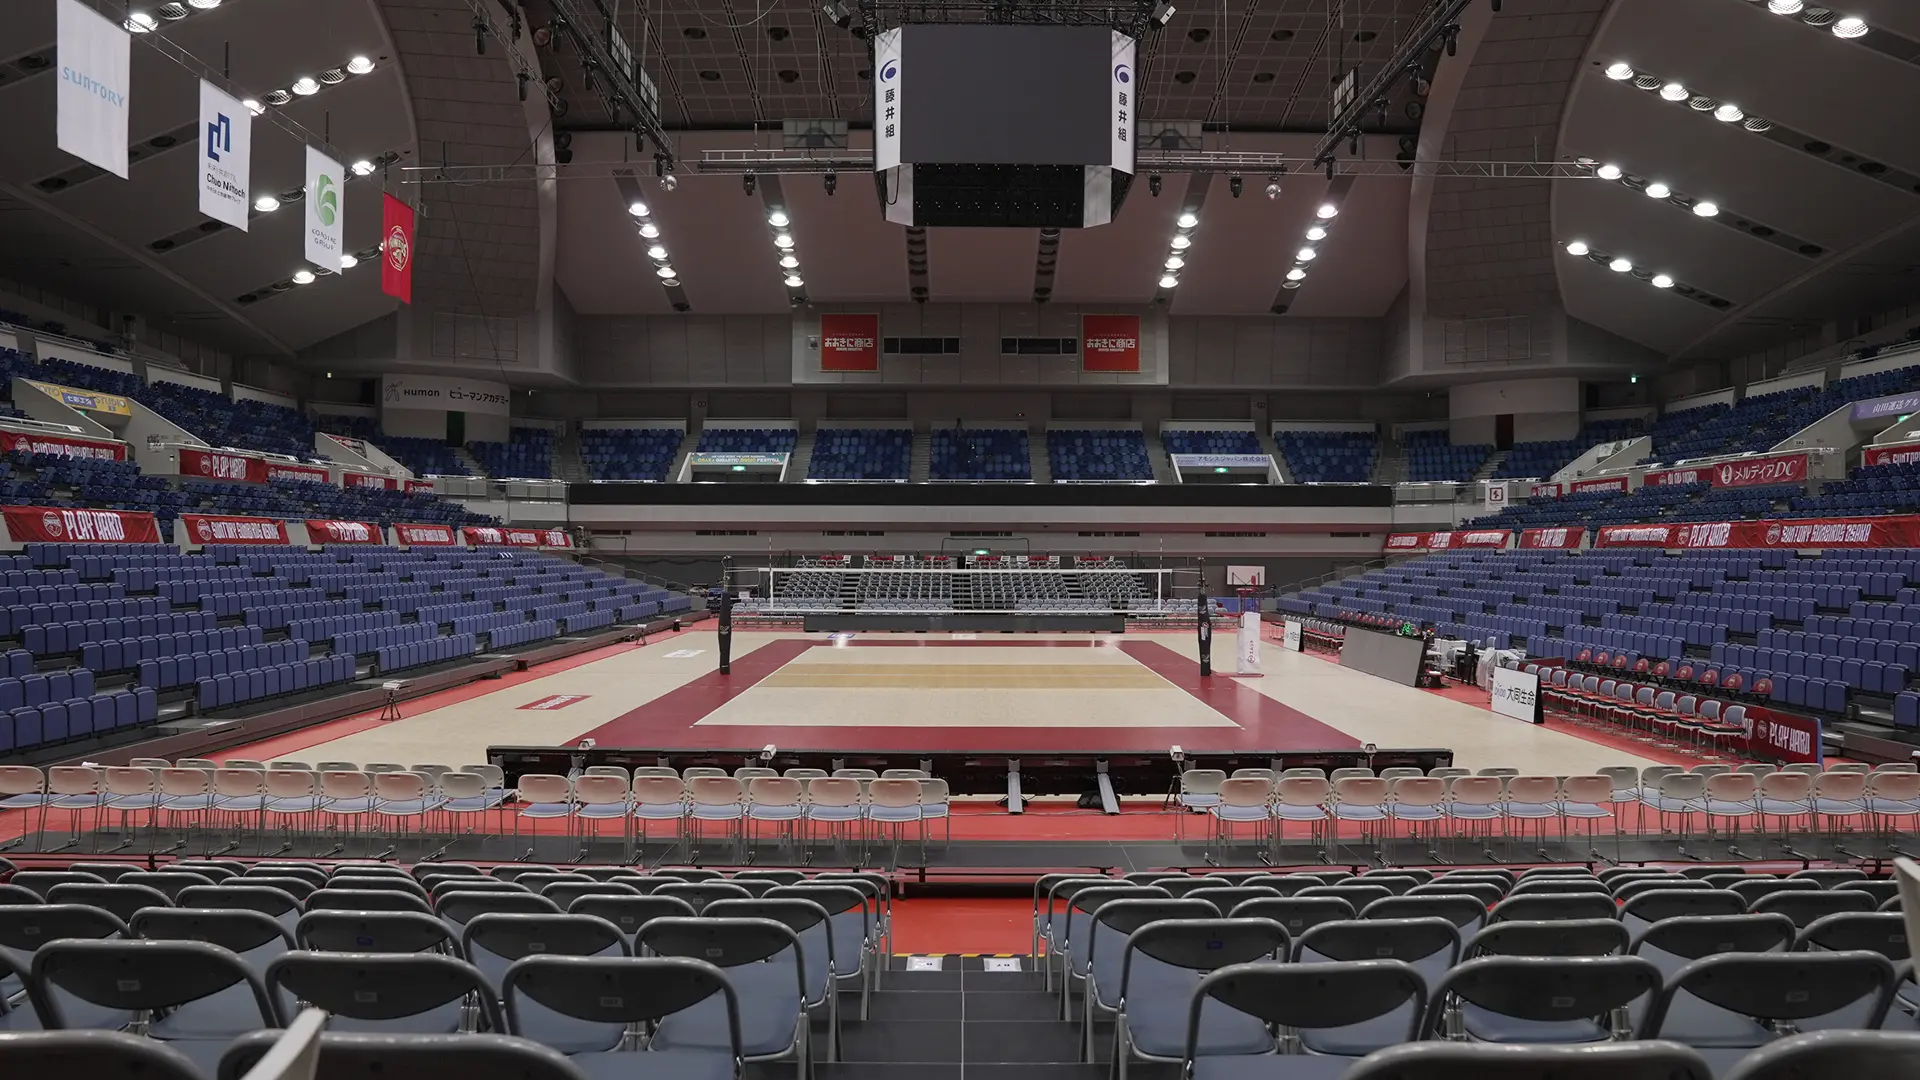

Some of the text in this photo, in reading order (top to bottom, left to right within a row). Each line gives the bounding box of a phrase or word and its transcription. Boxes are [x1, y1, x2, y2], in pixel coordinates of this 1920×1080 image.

[62, 66, 125, 108] SUNTORY
[885, 87, 895, 139] 藤井組
[1118, 91, 1128, 142] 藤井組
[206, 172, 221, 188] Chuo
[824, 337, 874, 348] おおきに商店
[1086, 338, 1136, 349] おおきに商店
[449, 386, 509, 405] ヒューマンアカデミー
[212, 456, 231, 479] PLAY
[1734, 460, 1797, 482] メルディアDC
[61, 510, 126, 541] PLAY HARD
[1688, 524, 1711, 547] PLAY
[1781, 525, 1812, 543] SUNTORY
[1506, 685, 1536, 707] 大同生命
[1769, 721, 1789, 749] PLAY
[1789, 727, 1811, 755] HARD
